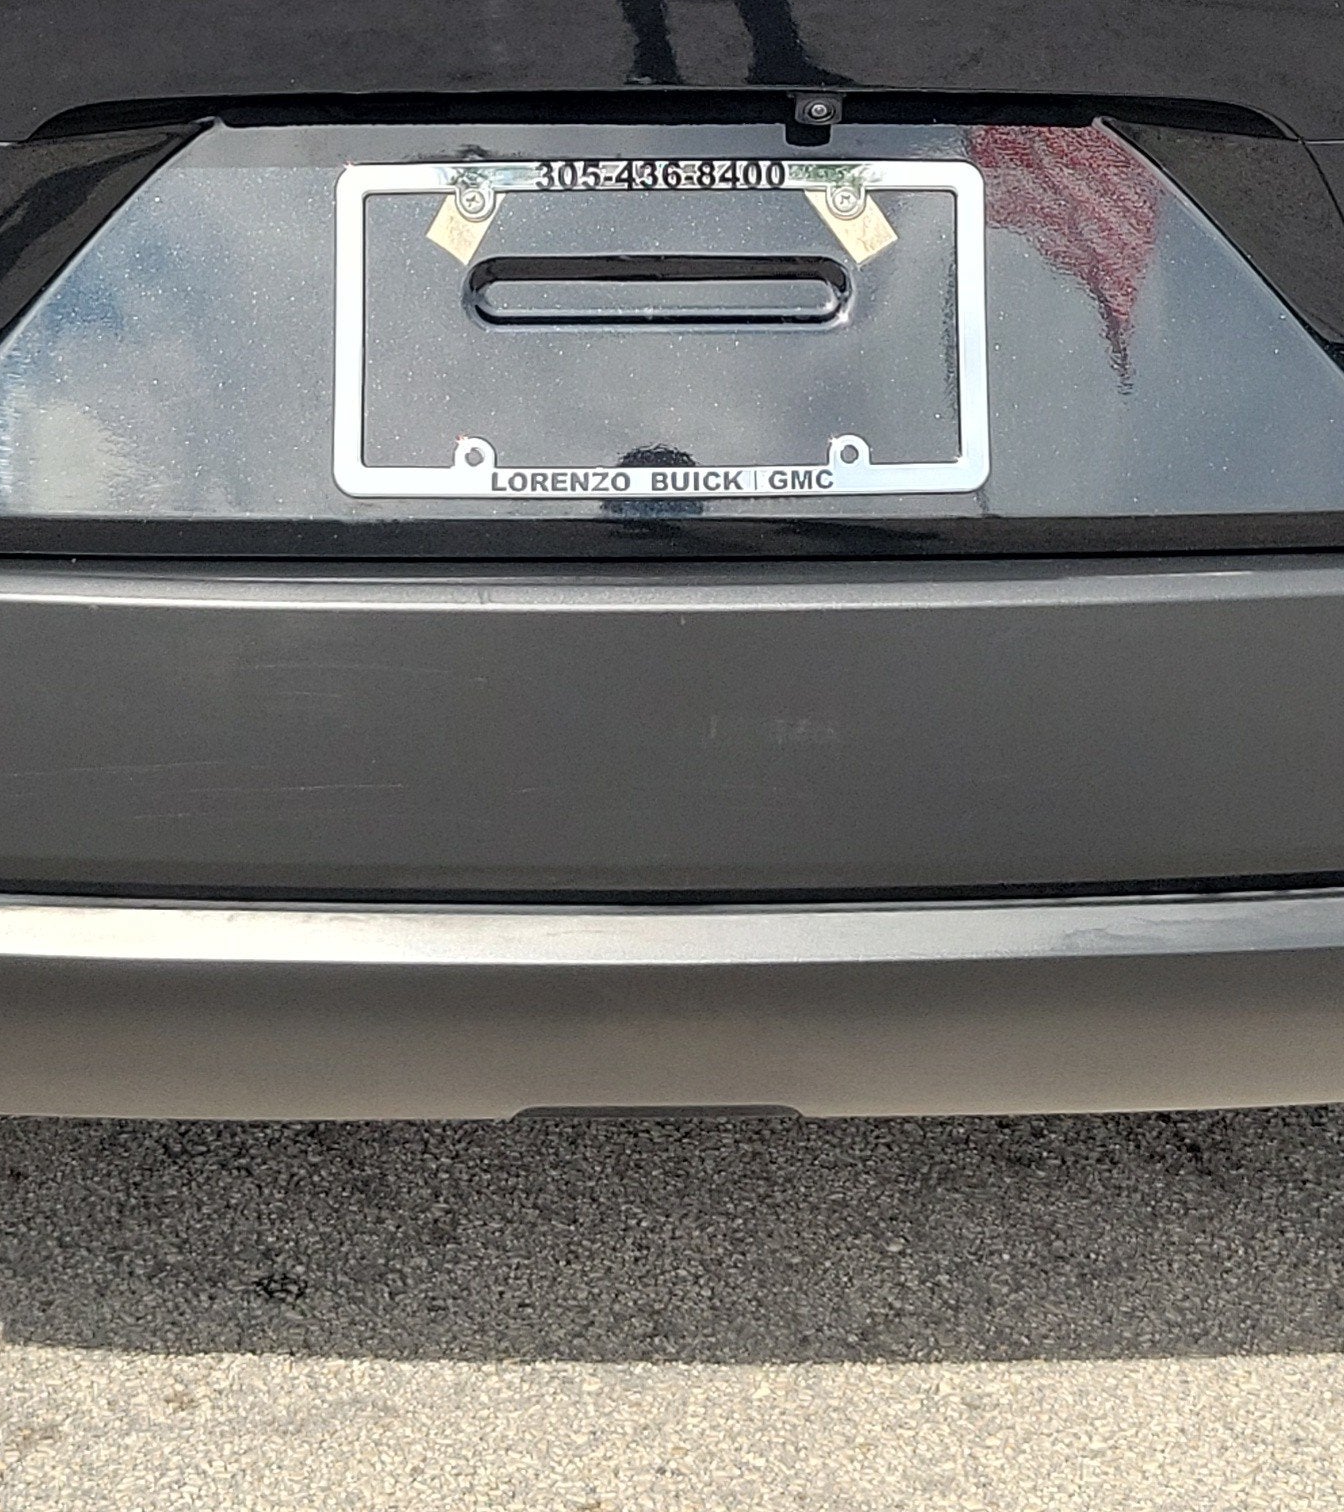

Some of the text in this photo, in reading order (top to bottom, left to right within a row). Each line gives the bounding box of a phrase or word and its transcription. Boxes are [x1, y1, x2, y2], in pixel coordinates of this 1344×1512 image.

[535, 161, 786, 190] 305-436-8400
[491, 469, 834, 492] LORENZO BUICK GMC
